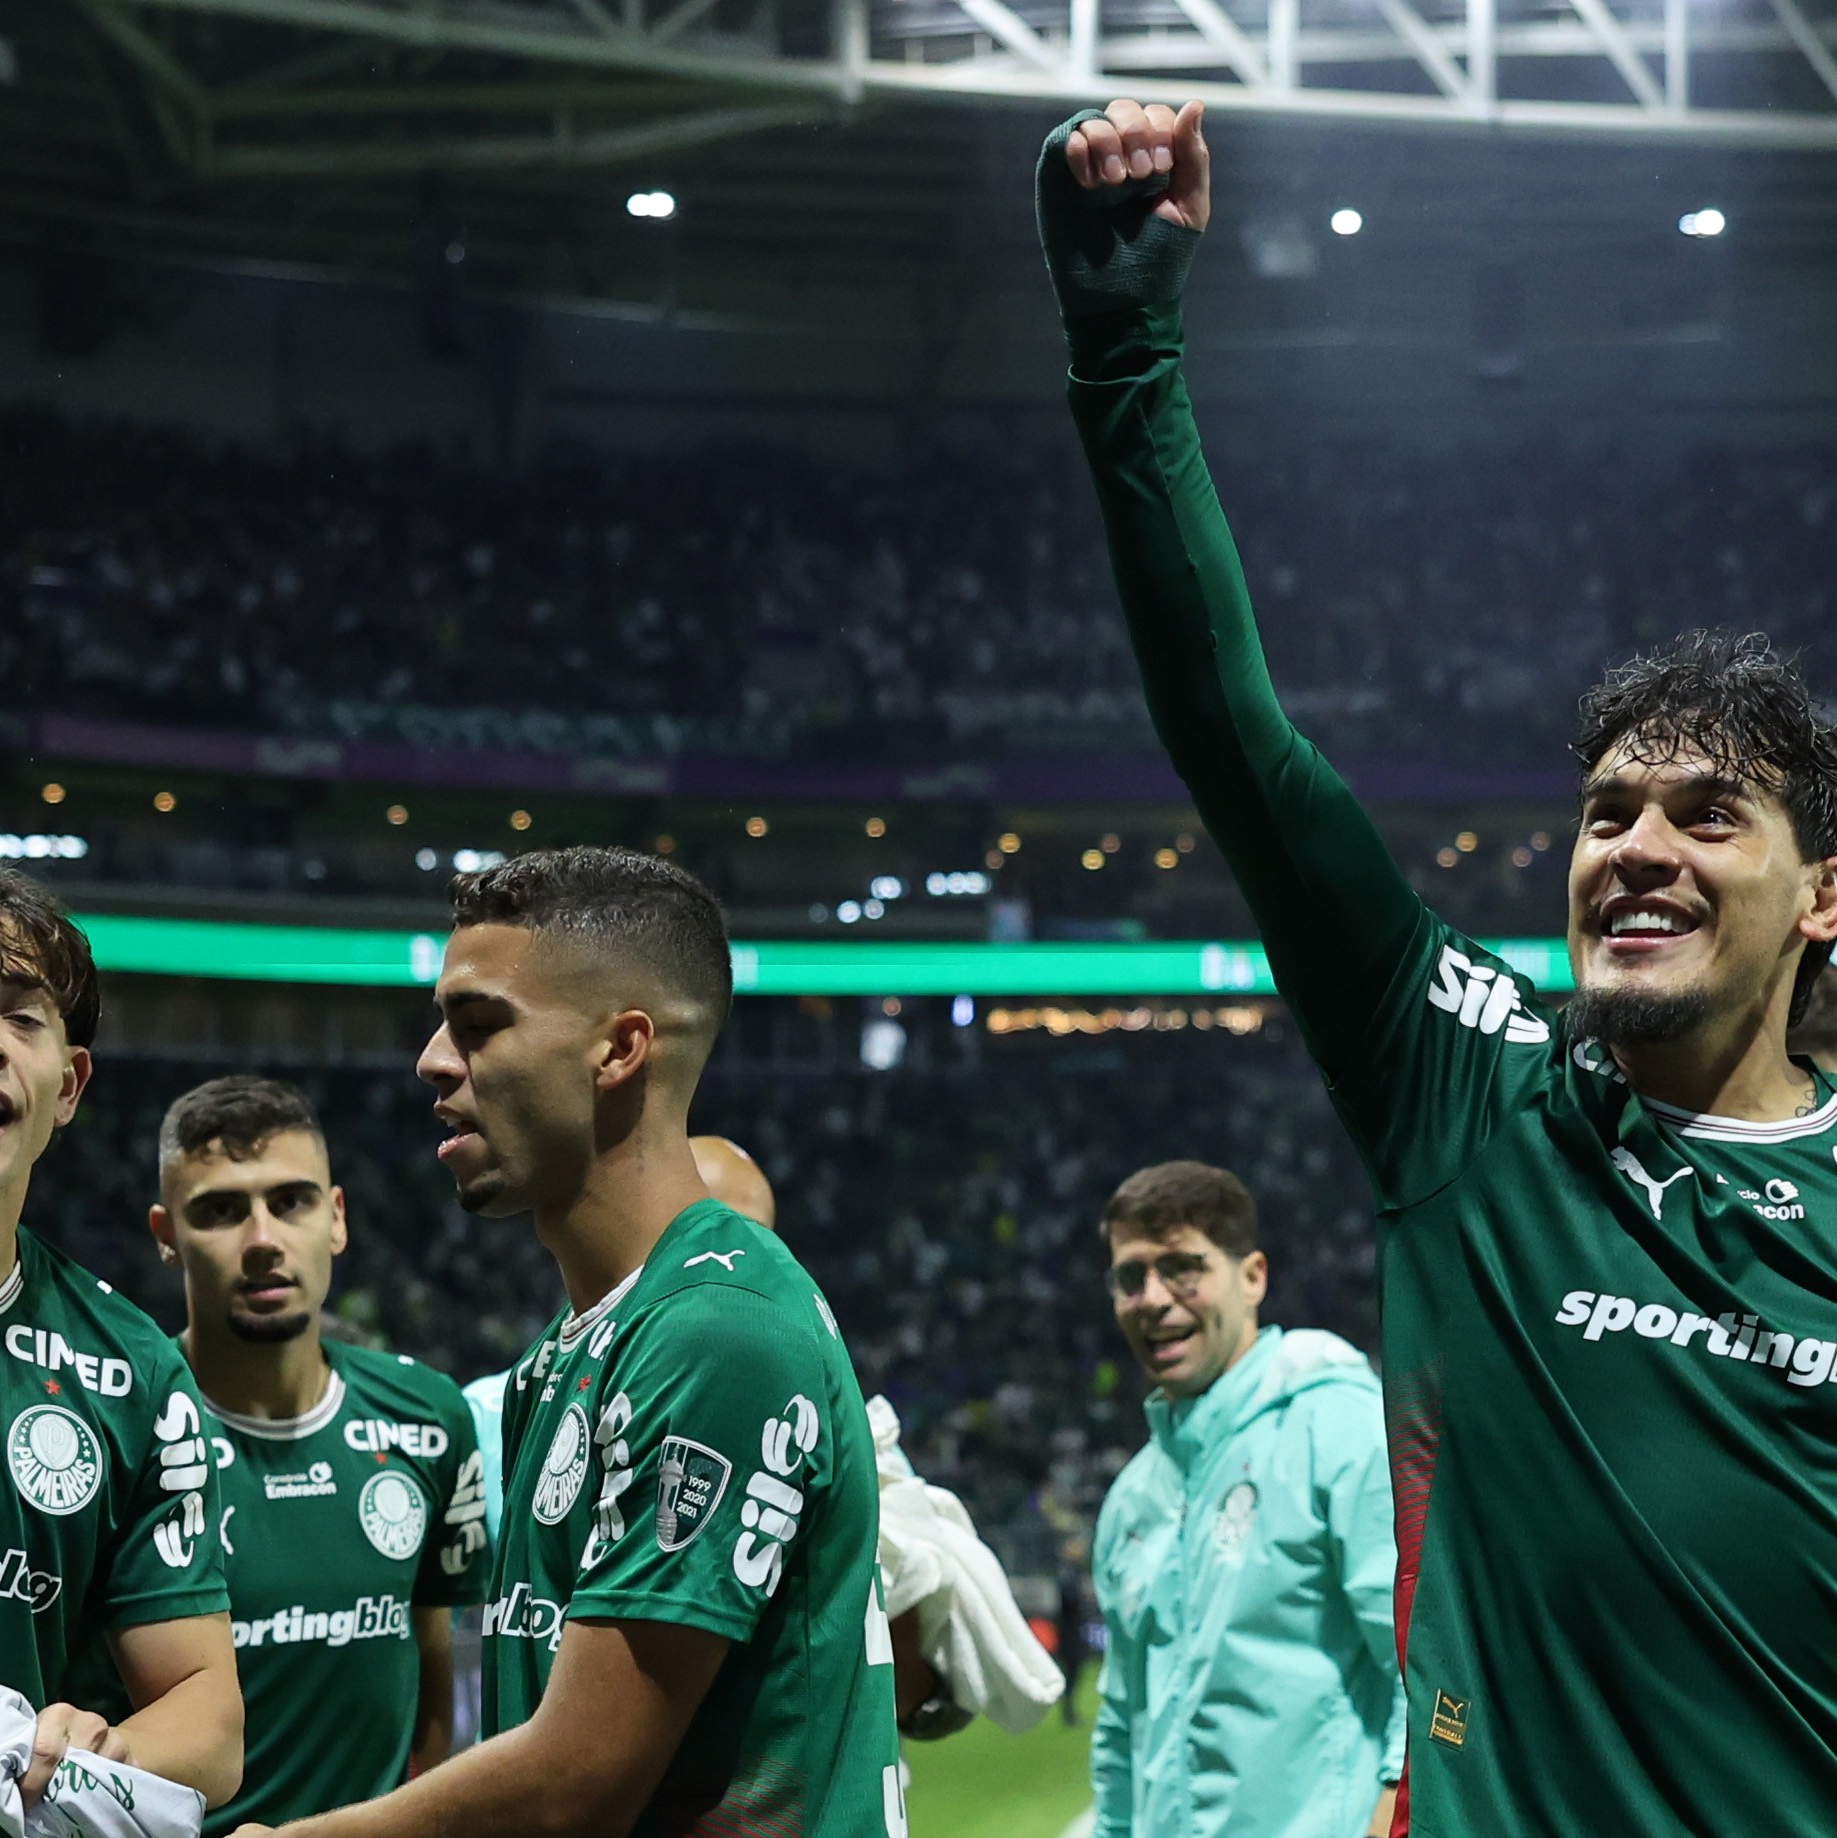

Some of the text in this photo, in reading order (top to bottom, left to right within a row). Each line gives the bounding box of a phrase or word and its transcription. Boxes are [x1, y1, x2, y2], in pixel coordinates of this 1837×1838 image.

[13, 1445, 97, 1509] PALMEIRAS
[688, 1475, 712, 1492] 1999
[682, 1488, 707, 1506] 2020
[676, 1500, 698, 1519] 2021
